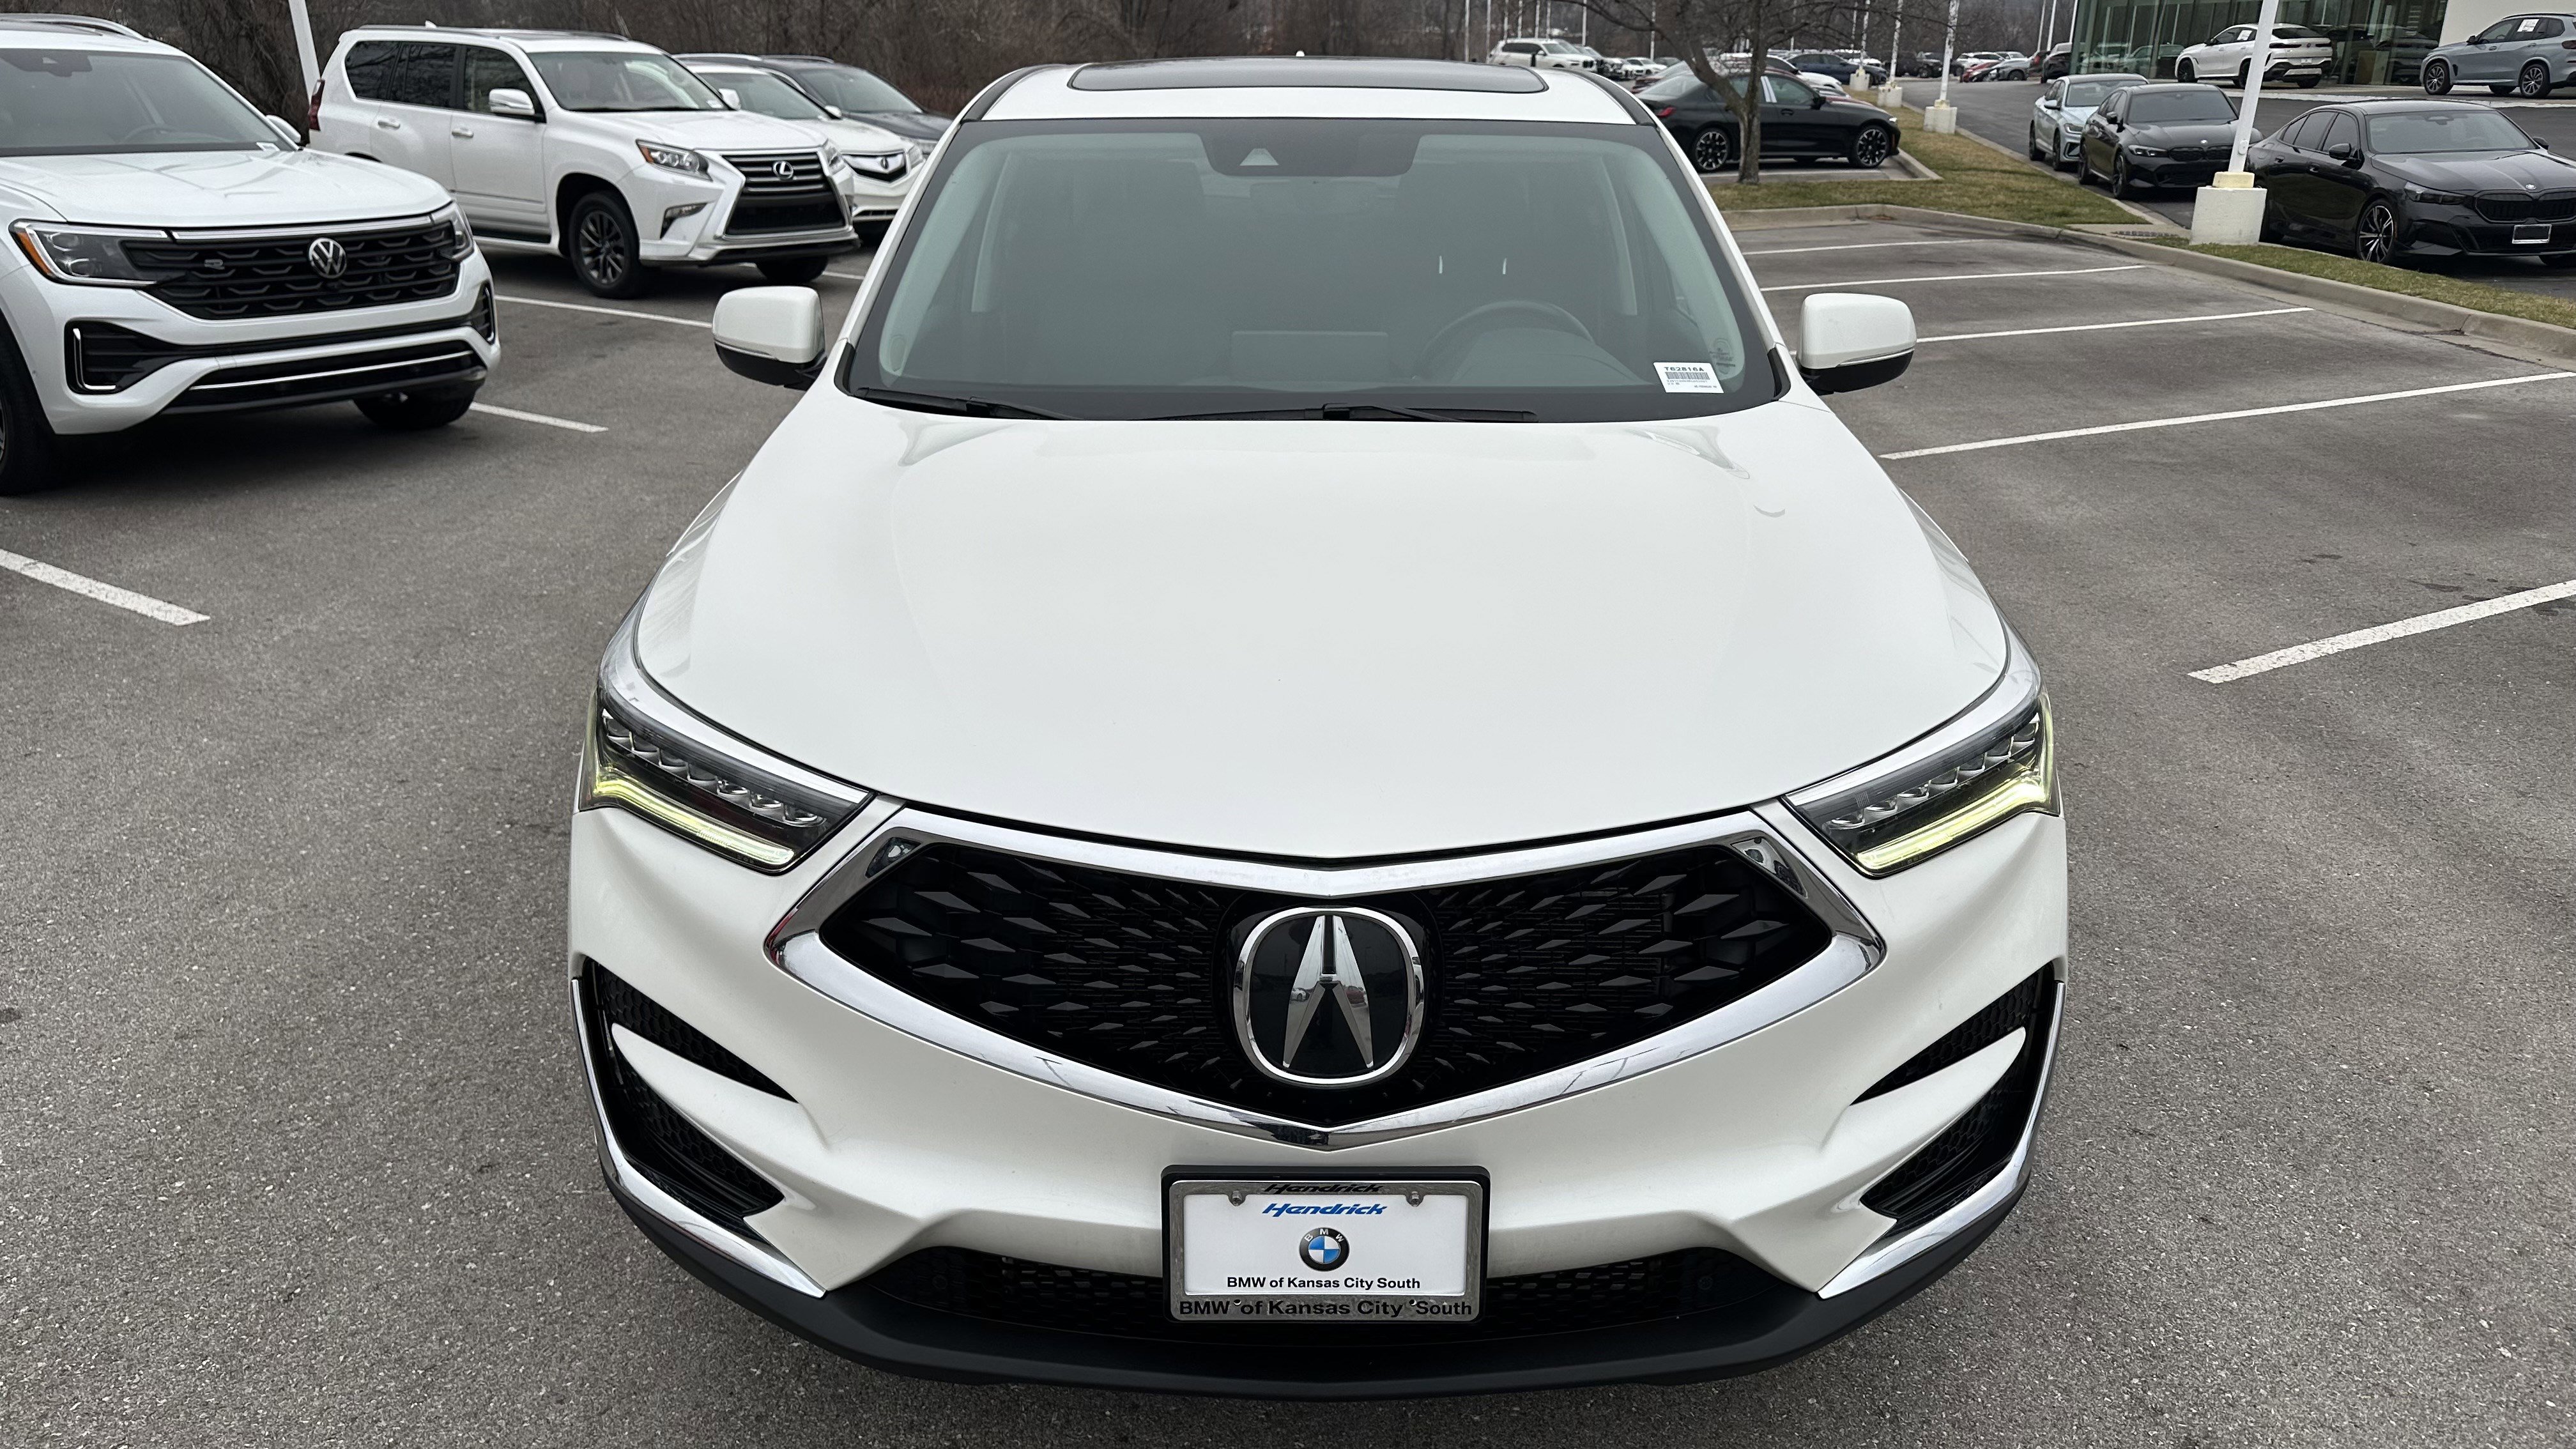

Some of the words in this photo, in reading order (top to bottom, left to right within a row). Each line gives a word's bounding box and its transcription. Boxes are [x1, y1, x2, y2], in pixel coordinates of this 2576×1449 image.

[1264, 1183, 1383, 1195] Hendrick
[1262, 1203, 1388, 1217] Hendrick
[1303, 1228, 1344, 1242] BMW
[1227, 1277, 1266, 1288] BMW
[1269, 1277, 1284, 1288] of
[1287, 1277, 1340, 1288] Kansas
[1344, 1277, 1374, 1291] City
[1377, 1277, 1421, 1289] South
[1179, 1301, 1230, 1315] BMW
[1240, 1300, 1263, 1315] of
[1269, 1300, 1351, 1315] Kansas
[1357, 1300, 1403, 1317] City
[1416, 1300, 1472, 1315] South
